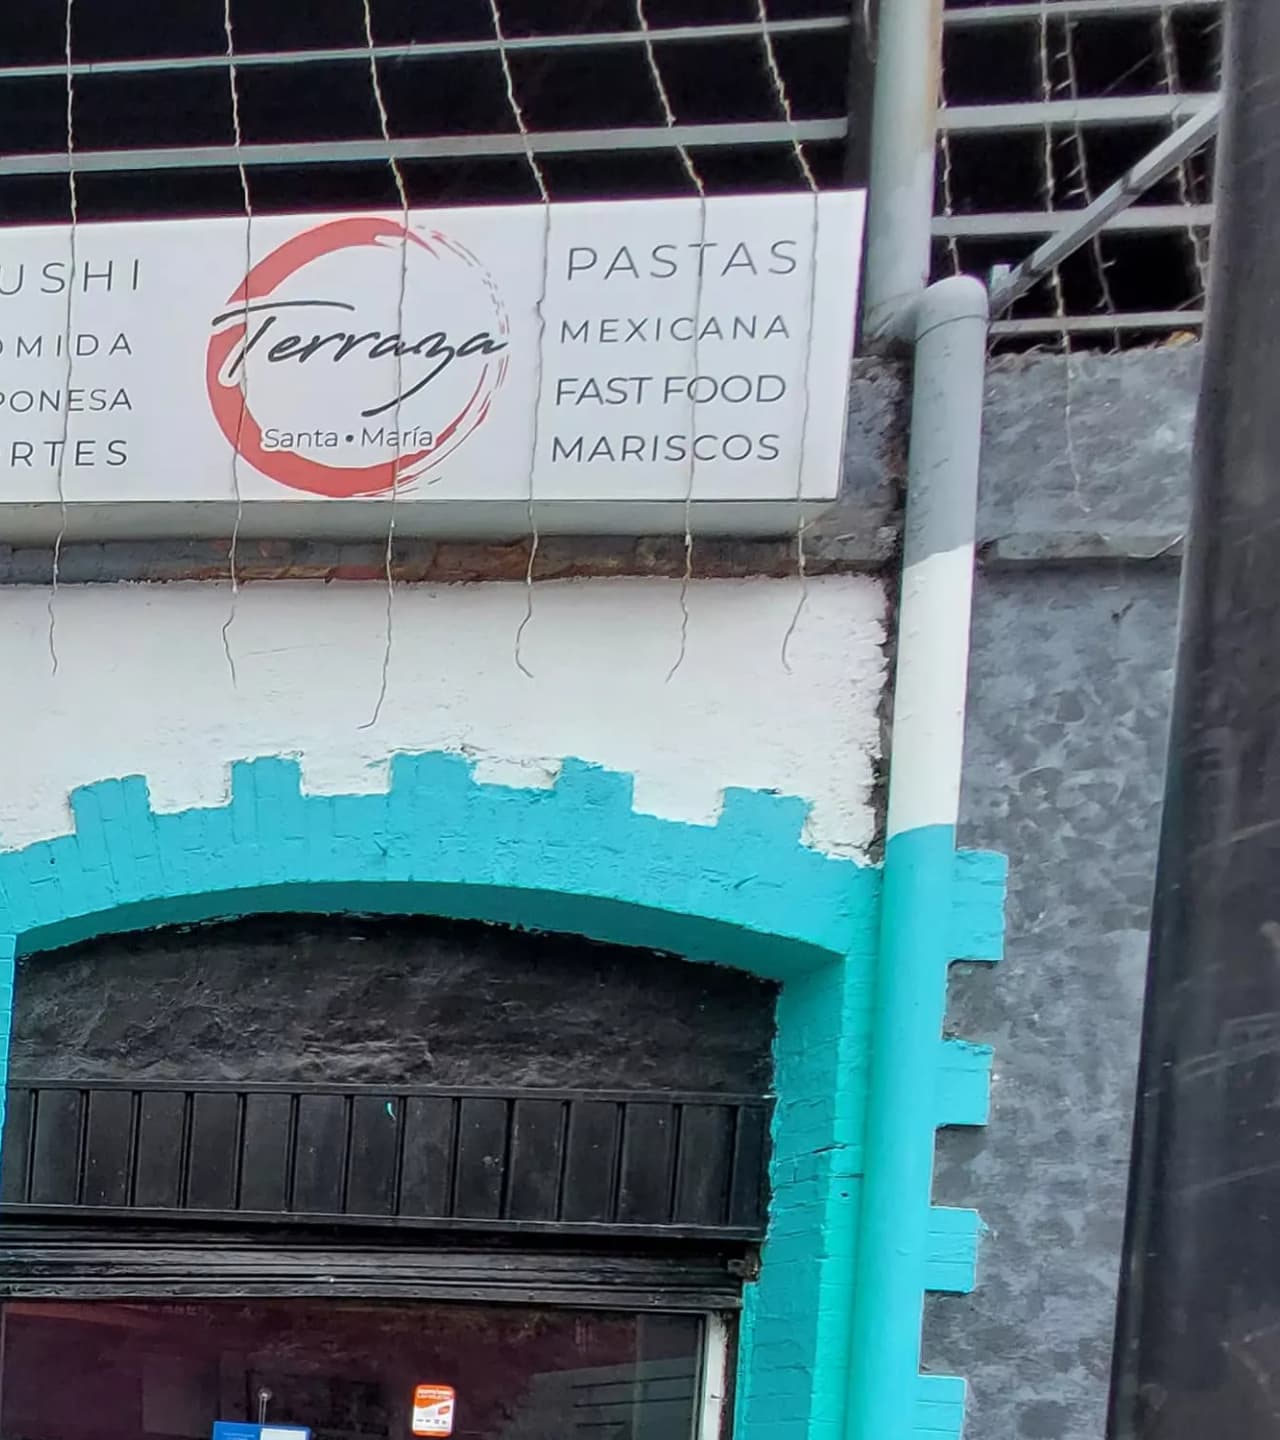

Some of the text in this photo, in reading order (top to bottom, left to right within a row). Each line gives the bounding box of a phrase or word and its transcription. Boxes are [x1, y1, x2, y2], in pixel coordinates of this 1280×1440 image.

[567, 239, 798, 281] PASTAS
[560, 314, 790, 344] MEXICANA
[211, 299, 509, 418] Terraza
[555, 374, 787, 406] FAST FOOD
[263, 425, 434, 449] Santa María
[551, 433, 781, 463] MARISCOS
